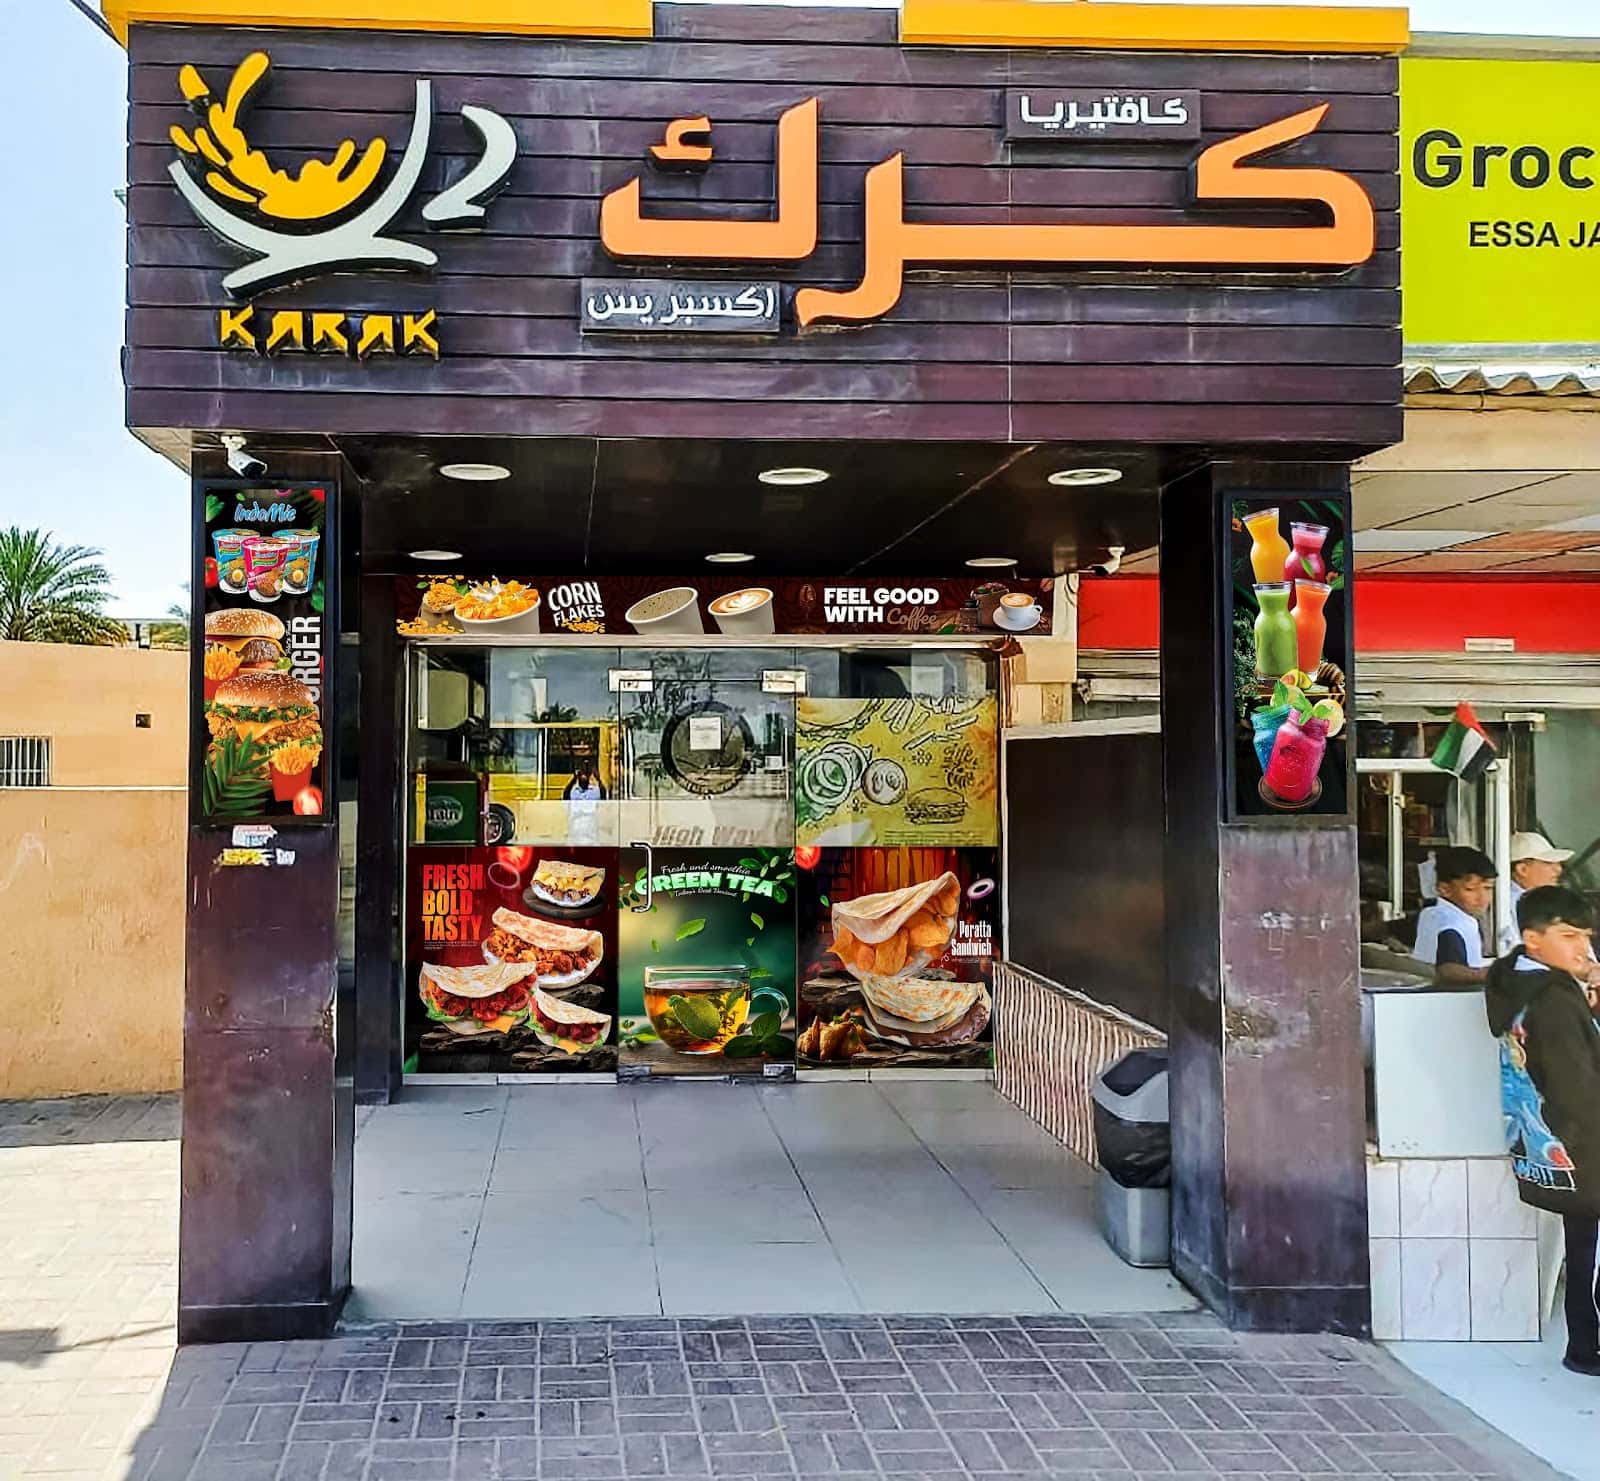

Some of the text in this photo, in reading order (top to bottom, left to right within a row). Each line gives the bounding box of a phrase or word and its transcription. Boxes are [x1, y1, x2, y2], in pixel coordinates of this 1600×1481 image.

[1020, 95, 1188, 129] كافتيريا
[1413, 129, 1595, 189] Groc
[1469, 221, 1560, 247] ESSA
[220, 304, 439, 358] KARAK
[548, 581, 602, 611] CORN
[824, 587, 940, 605] FEEL GOOD
[553, 603, 605, 627] FLAKES
[824, 605, 938, 631] WITH Coffee
[291, 616, 321, 720] RGER
[423, 864, 483, 890] FRESH
[661, 862, 687, 875] Fresh
[689, 861, 709, 872] and
[634, 872, 722, 895] GREEN
[726, 873, 774, 897] TEA
[423, 889, 473, 915] BOLD
[421, 915, 482, 941] TASTY
[951, 938, 992, 956] Sandwich
